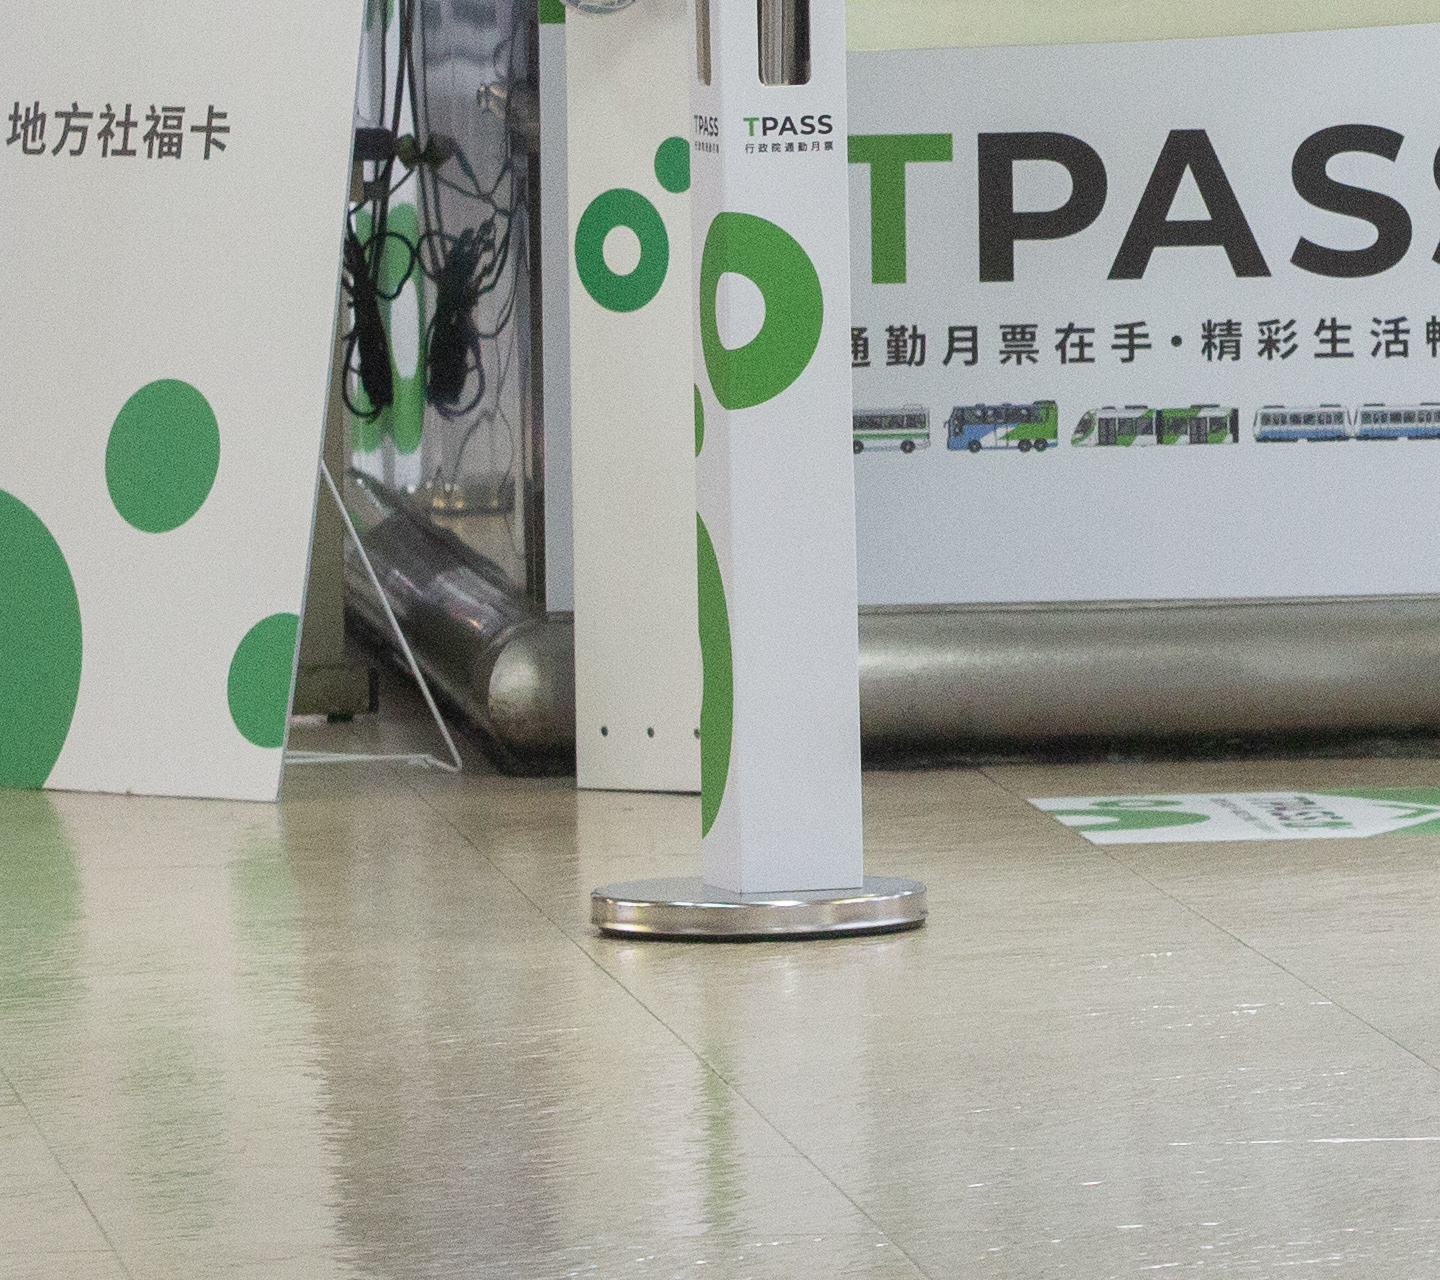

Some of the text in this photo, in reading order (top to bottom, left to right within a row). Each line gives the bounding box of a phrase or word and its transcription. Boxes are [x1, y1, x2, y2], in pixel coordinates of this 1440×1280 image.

[6, 101, 232, 161] 地方社福卡
[693, 115, 719, 137] TPASS
[743, 114, 833, 137] TPASS
[745, 141, 834, 154] 行政院通勤月票
